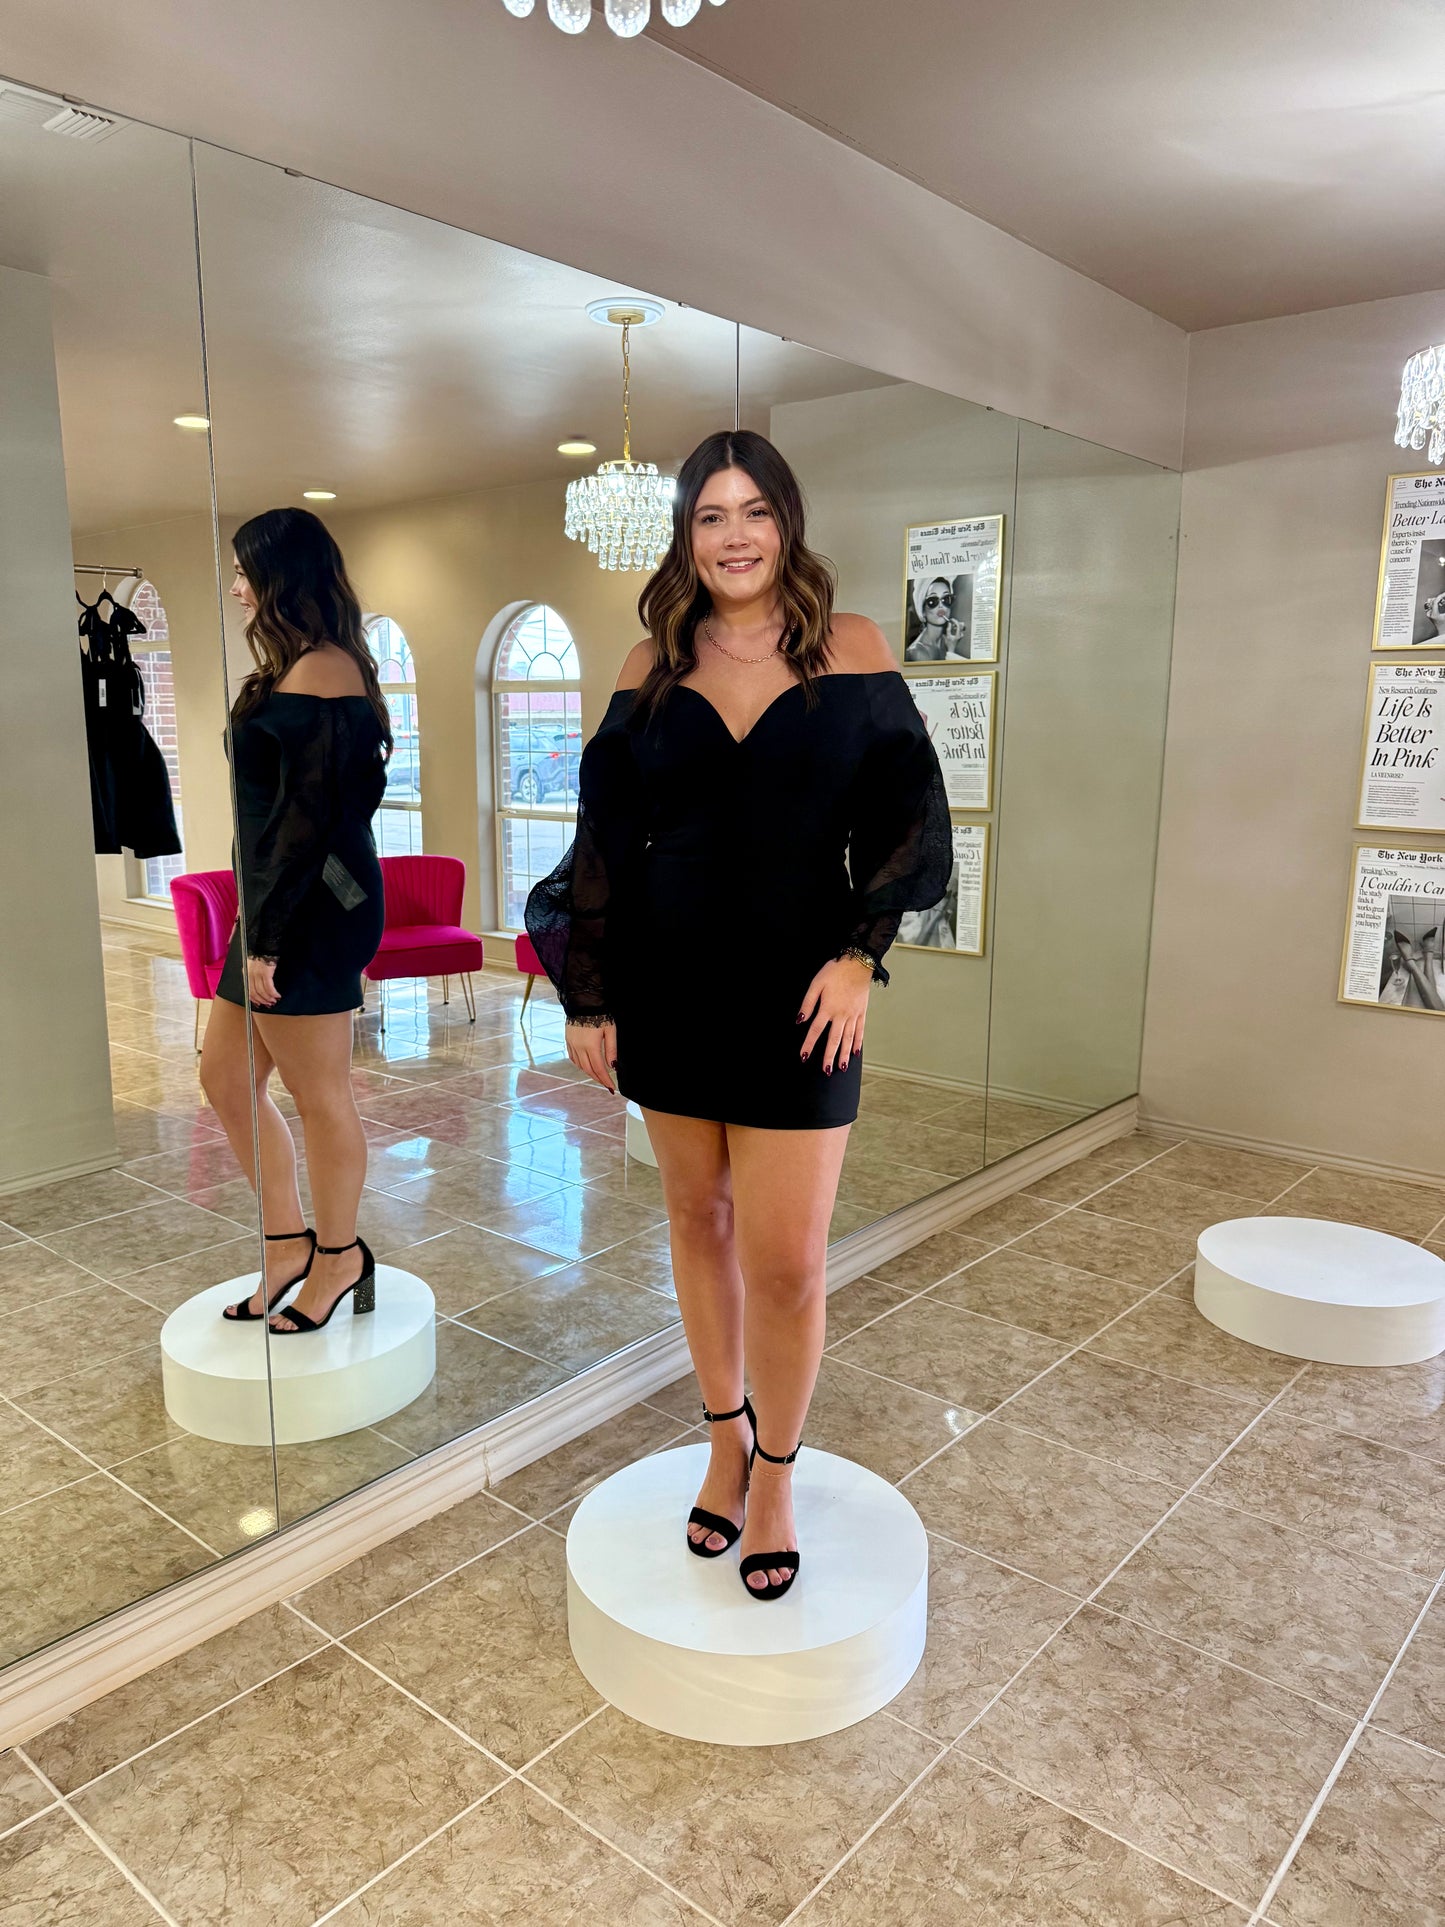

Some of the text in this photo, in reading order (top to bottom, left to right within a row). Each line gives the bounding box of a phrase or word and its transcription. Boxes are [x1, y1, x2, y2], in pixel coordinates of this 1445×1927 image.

[1414, 479, 1432, 489] The
[1393, 500, 1417, 509] Trending
[1392, 510, 1445, 527] Better La
[1392, 530, 1411, 539] Experts
[1395, 668, 1413, 677] The
[1415, 668, 1436, 677] New
[1379, 686, 1390, 694] New
[1390, 685, 1413, 694] Research
[1378, 696, 1433, 724] Life Is
[1375, 723, 1433, 744] Better
[1370, 747, 1439, 768] In Pink
[1377, 850, 1395, 860] The
[1397, 851, 1417, 861] New
[1419, 853, 1444, 863] York
[1361, 866, 1398, 876] Breaking News
[1360, 876, 1445, 895] I Couldn't Car
[1359, 888, 1368, 896] The
